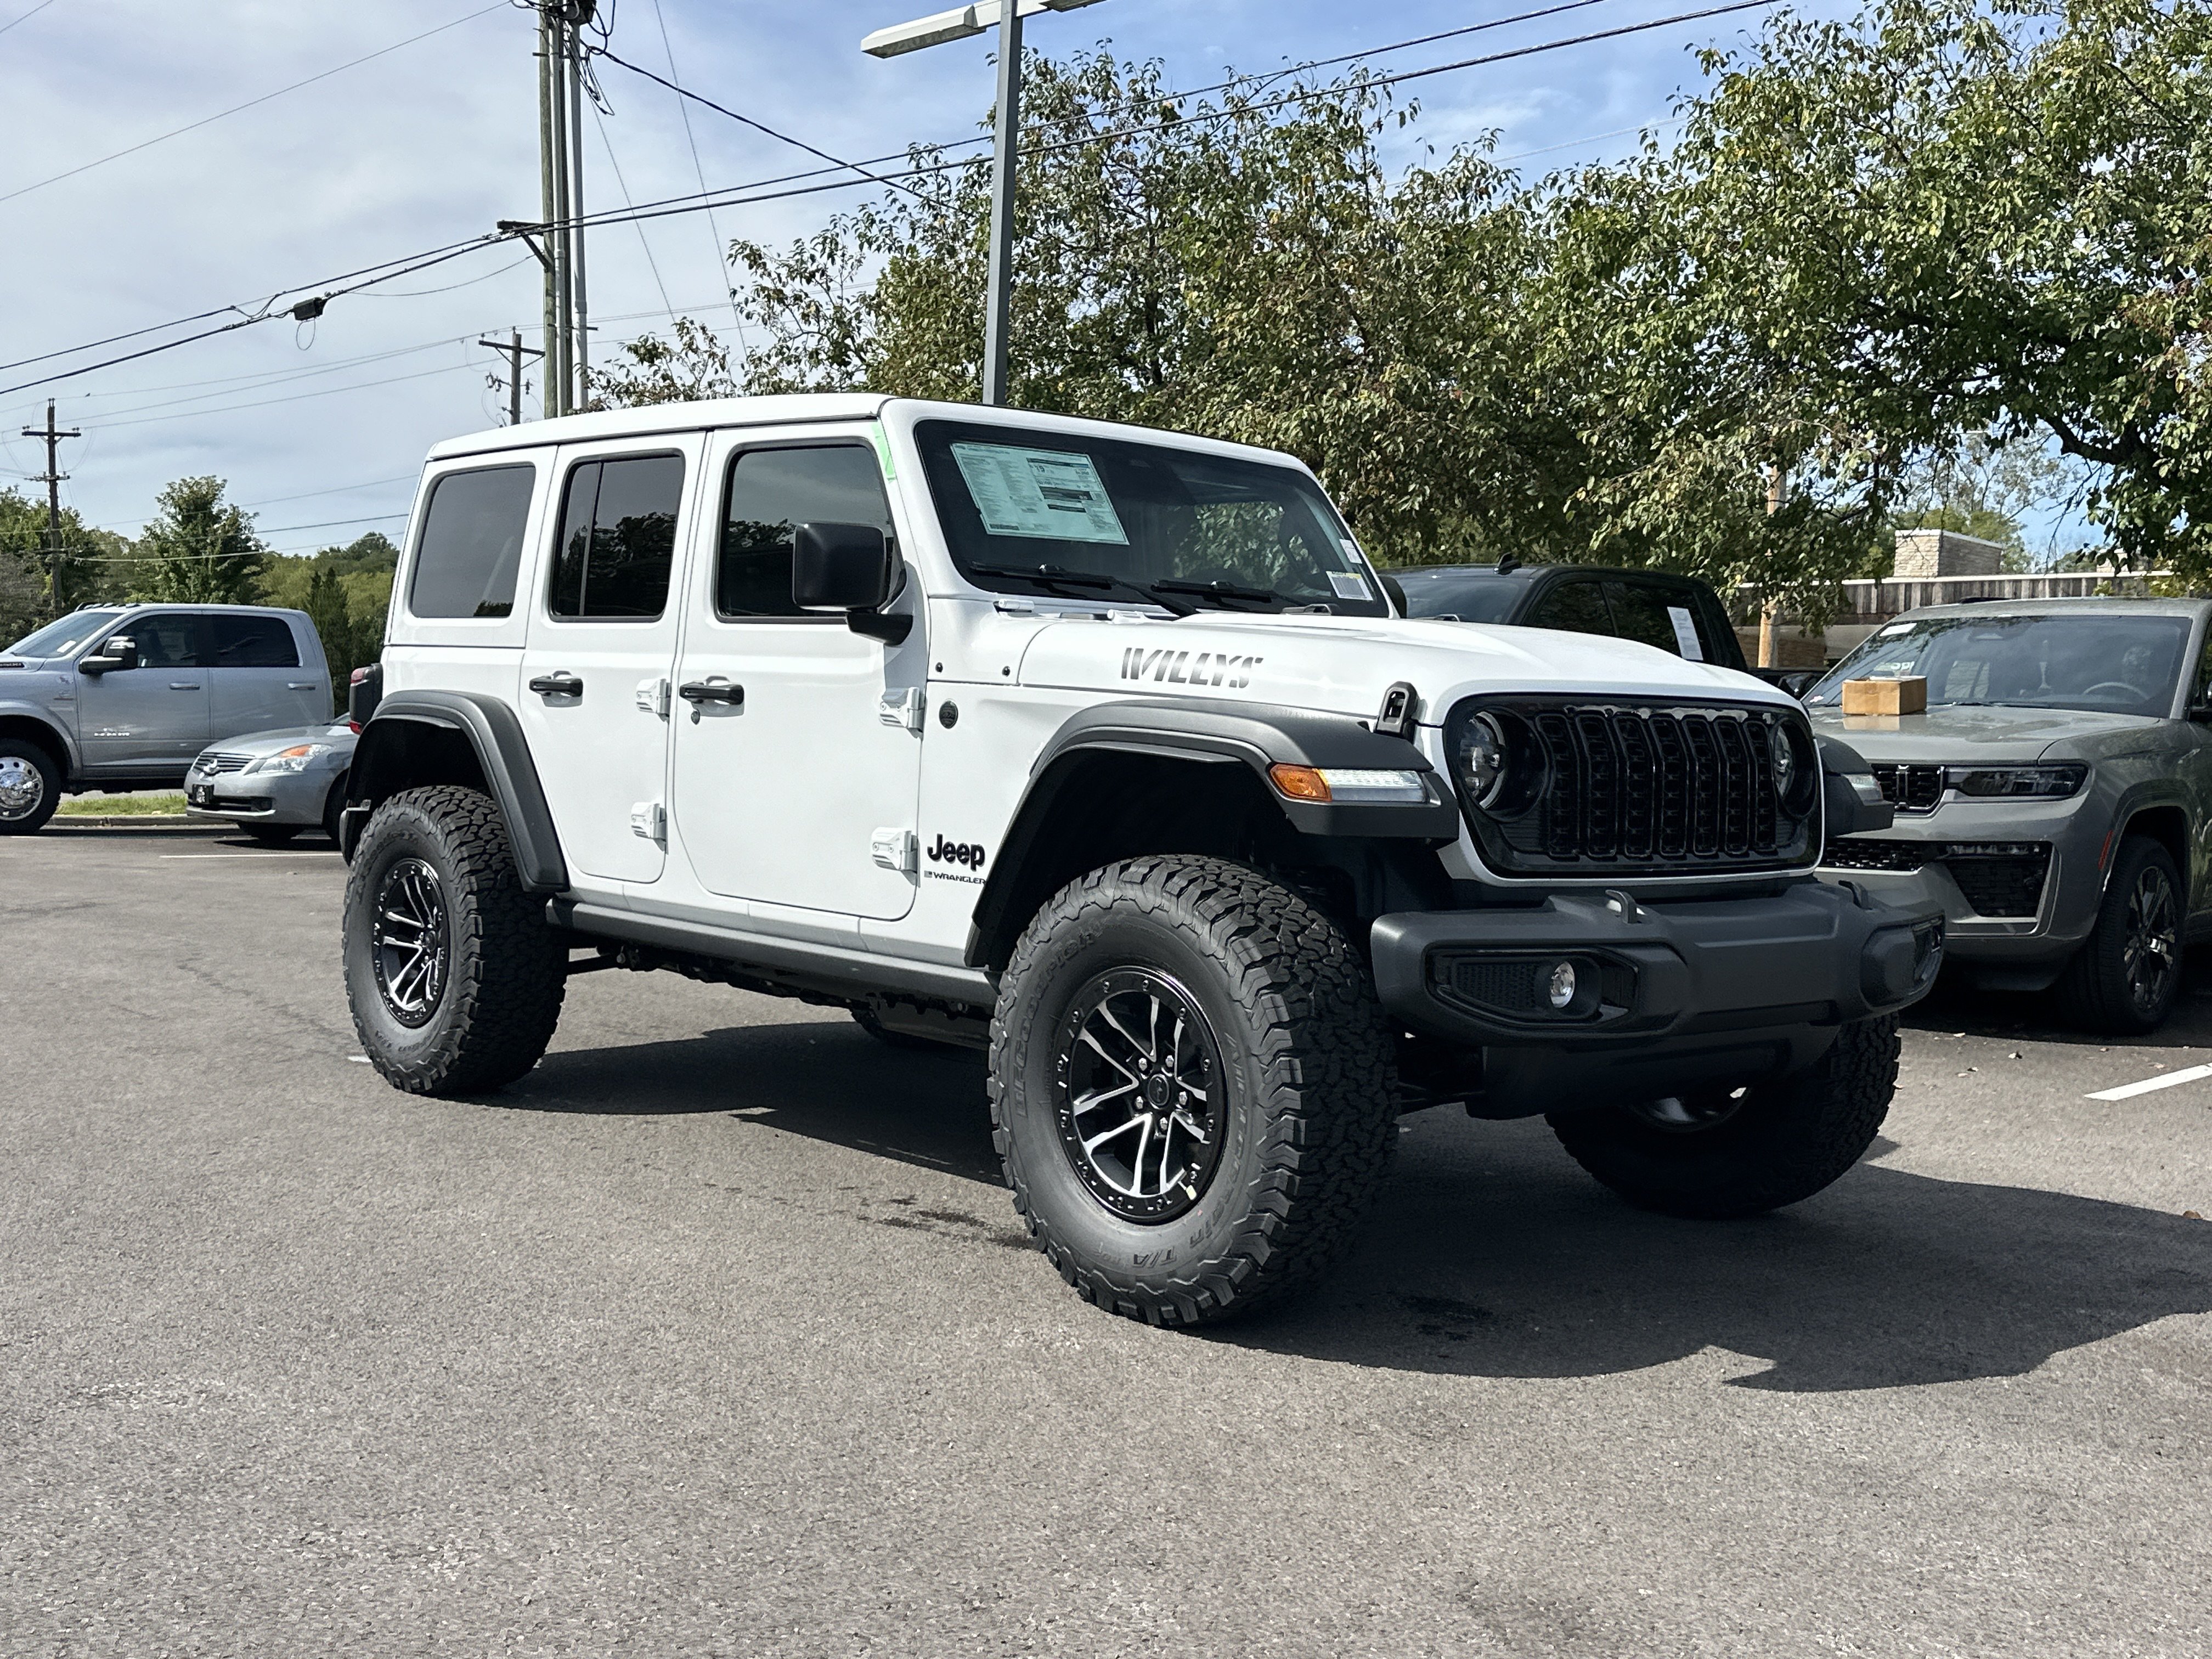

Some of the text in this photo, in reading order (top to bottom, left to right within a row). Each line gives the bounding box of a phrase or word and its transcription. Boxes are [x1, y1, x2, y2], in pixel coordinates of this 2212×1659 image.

[1121, 647, 1263, 688] WILLYS
[927, 833, 985, 872] Jeep
[933, 871, 986, 884] WRANGLER
[1132, 1245, 1178, 1268] T/A
